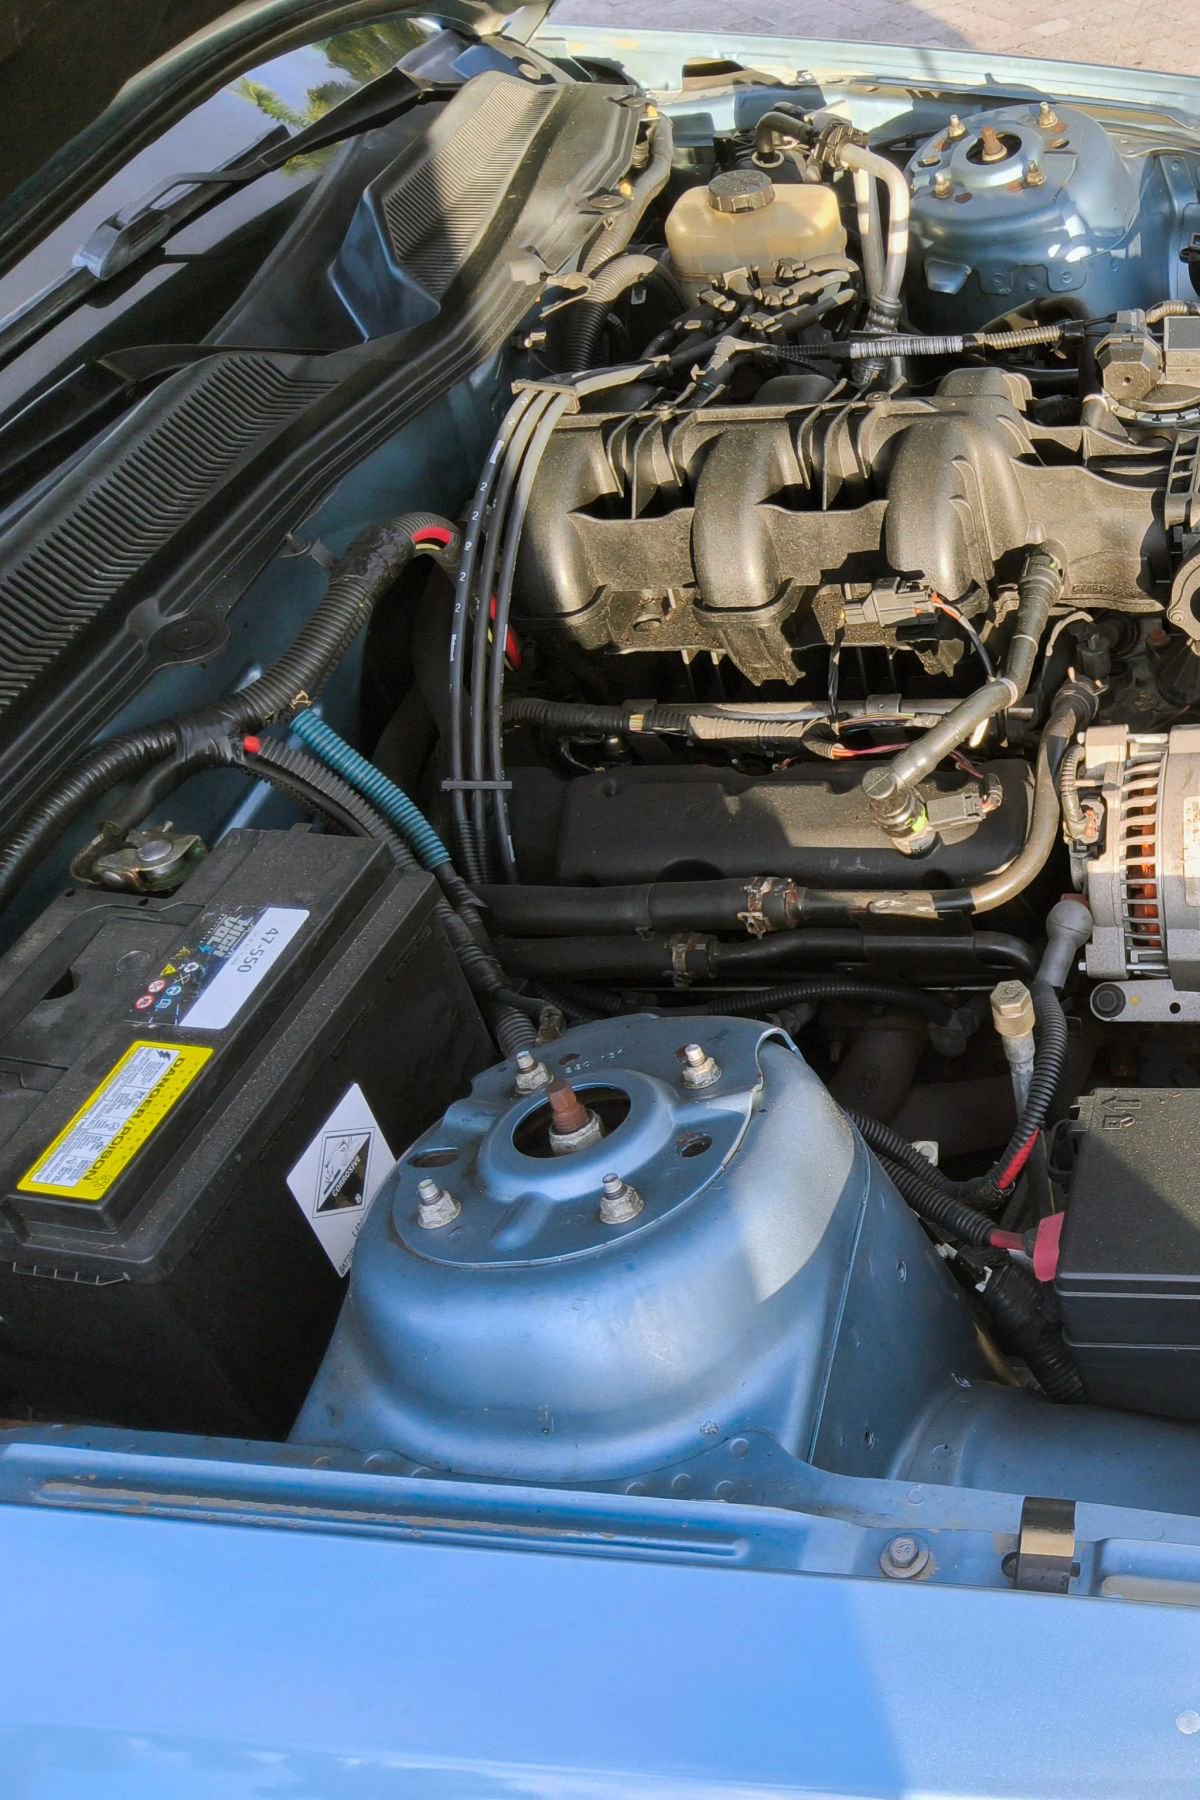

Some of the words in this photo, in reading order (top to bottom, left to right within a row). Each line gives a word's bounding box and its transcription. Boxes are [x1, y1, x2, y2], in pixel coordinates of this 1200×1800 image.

[237, 928, 279, 973] 47-550
[332, 1154, 361, 1197] CORROSIVE
[355, 1193, 362, 1204] 8
